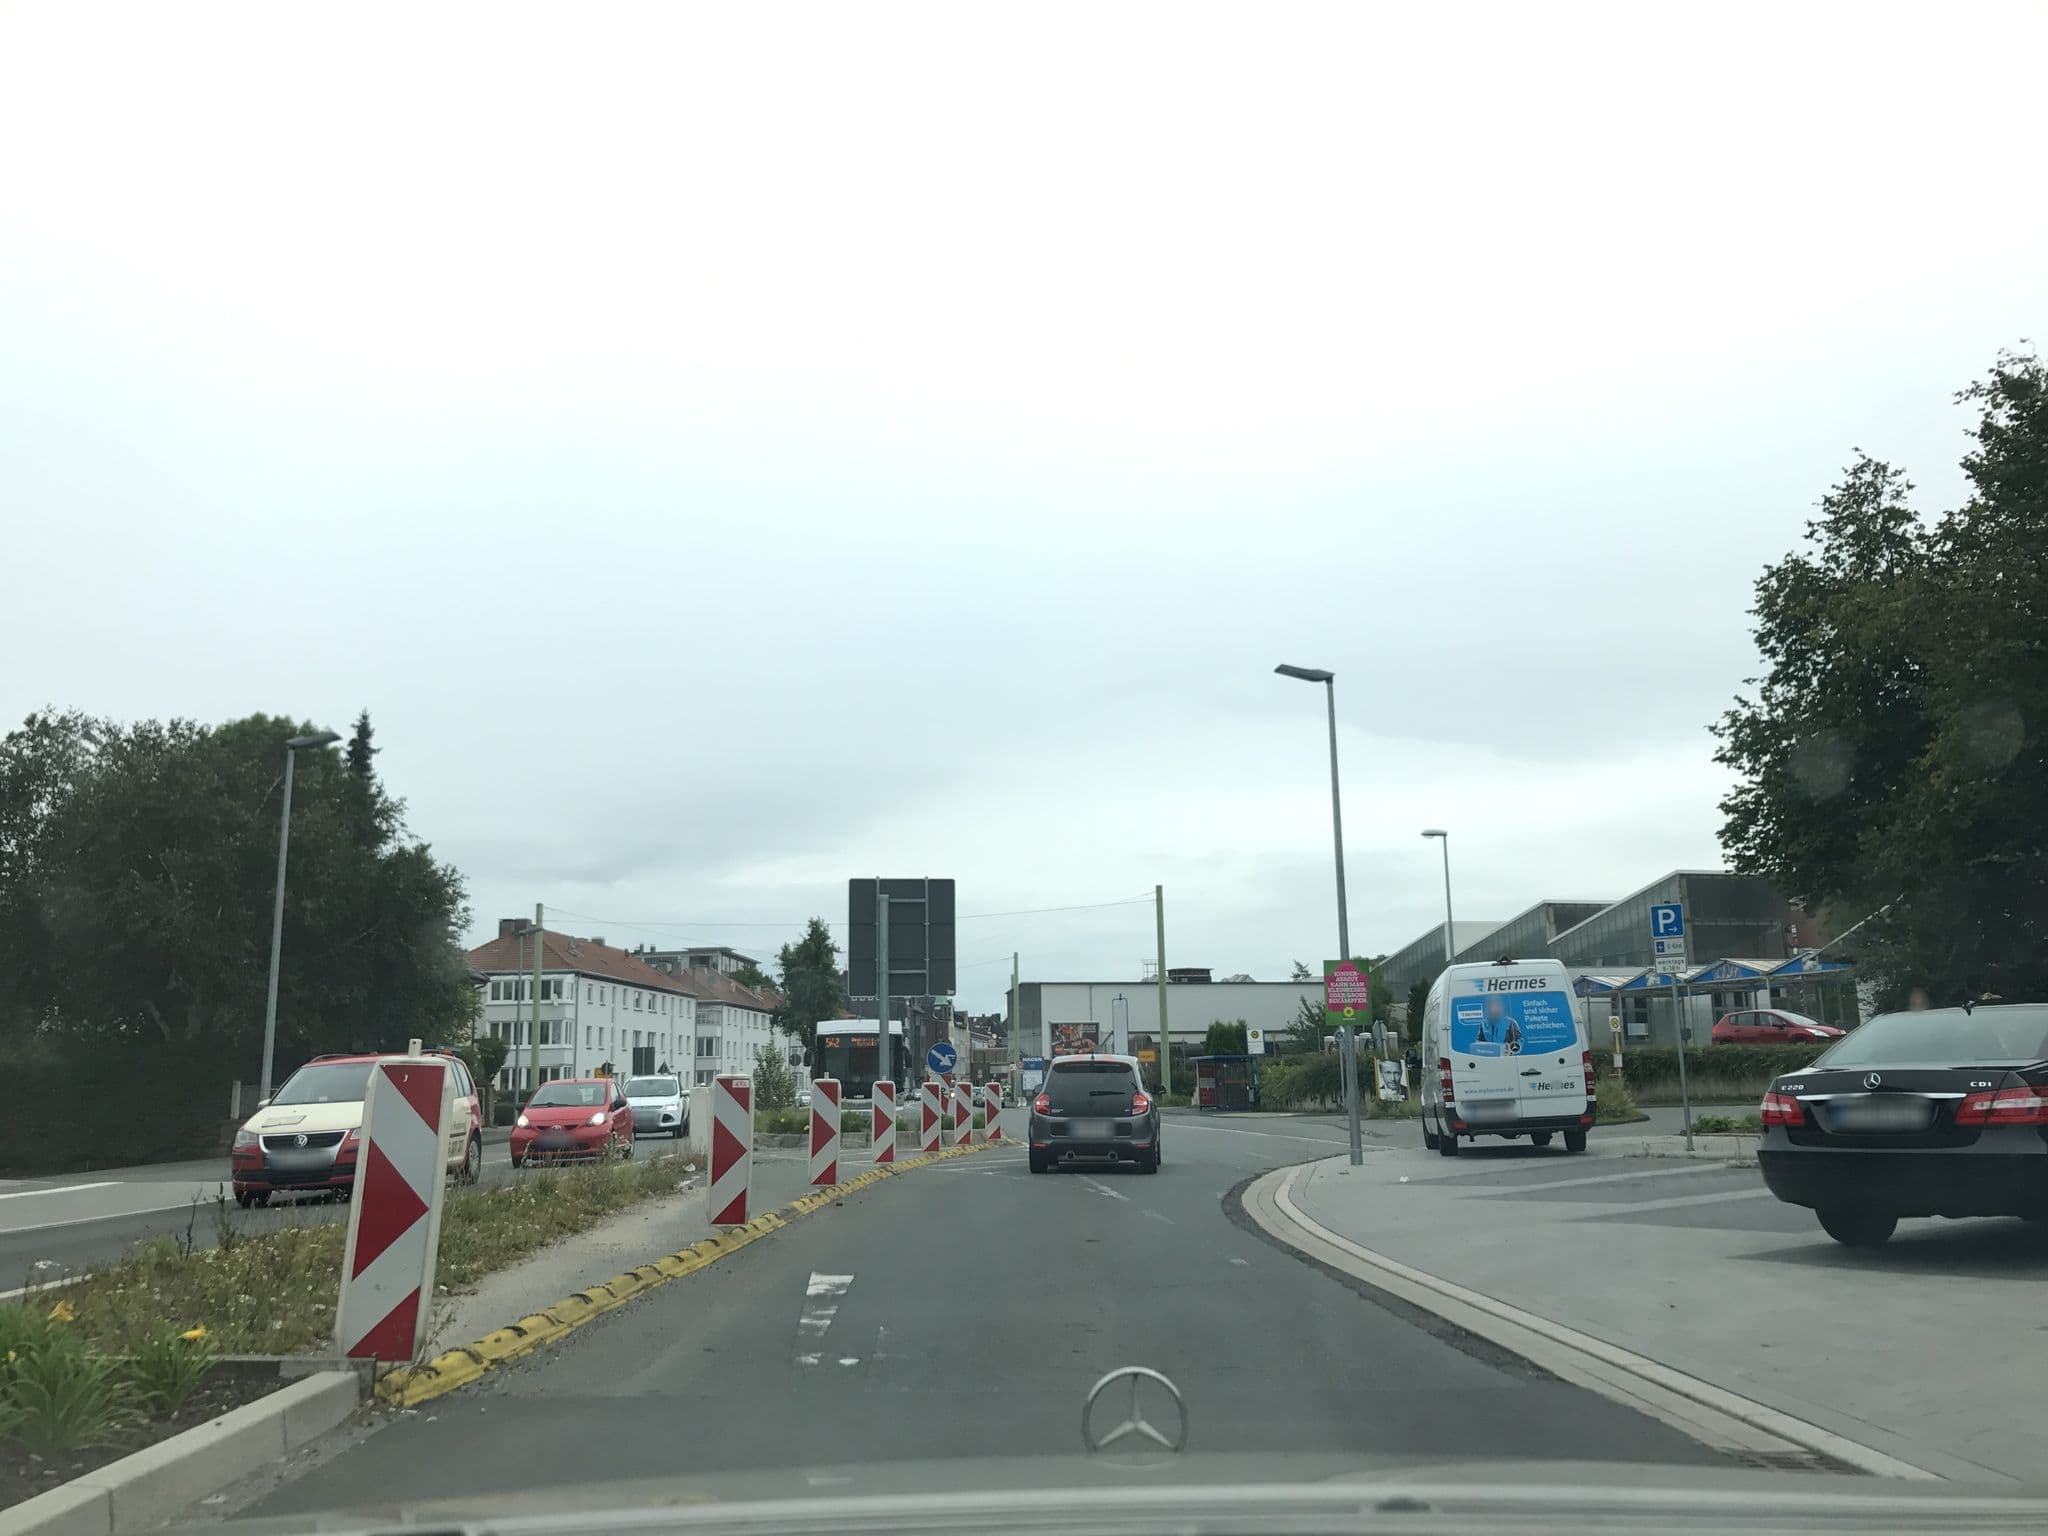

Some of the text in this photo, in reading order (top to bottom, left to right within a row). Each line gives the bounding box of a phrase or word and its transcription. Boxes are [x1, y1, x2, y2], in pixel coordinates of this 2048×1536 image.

[1658, 909, 1676, 934] P
[1487, 978, 1546, 991] Hermes
[1523, 999, 1548, 1007] Einfach
[1523, 1006, 1558, 1015] und sicher
[1524, 1015, 1548, 1023] Pakete
[1526, 1022, 1566, 1031] verschicken.
